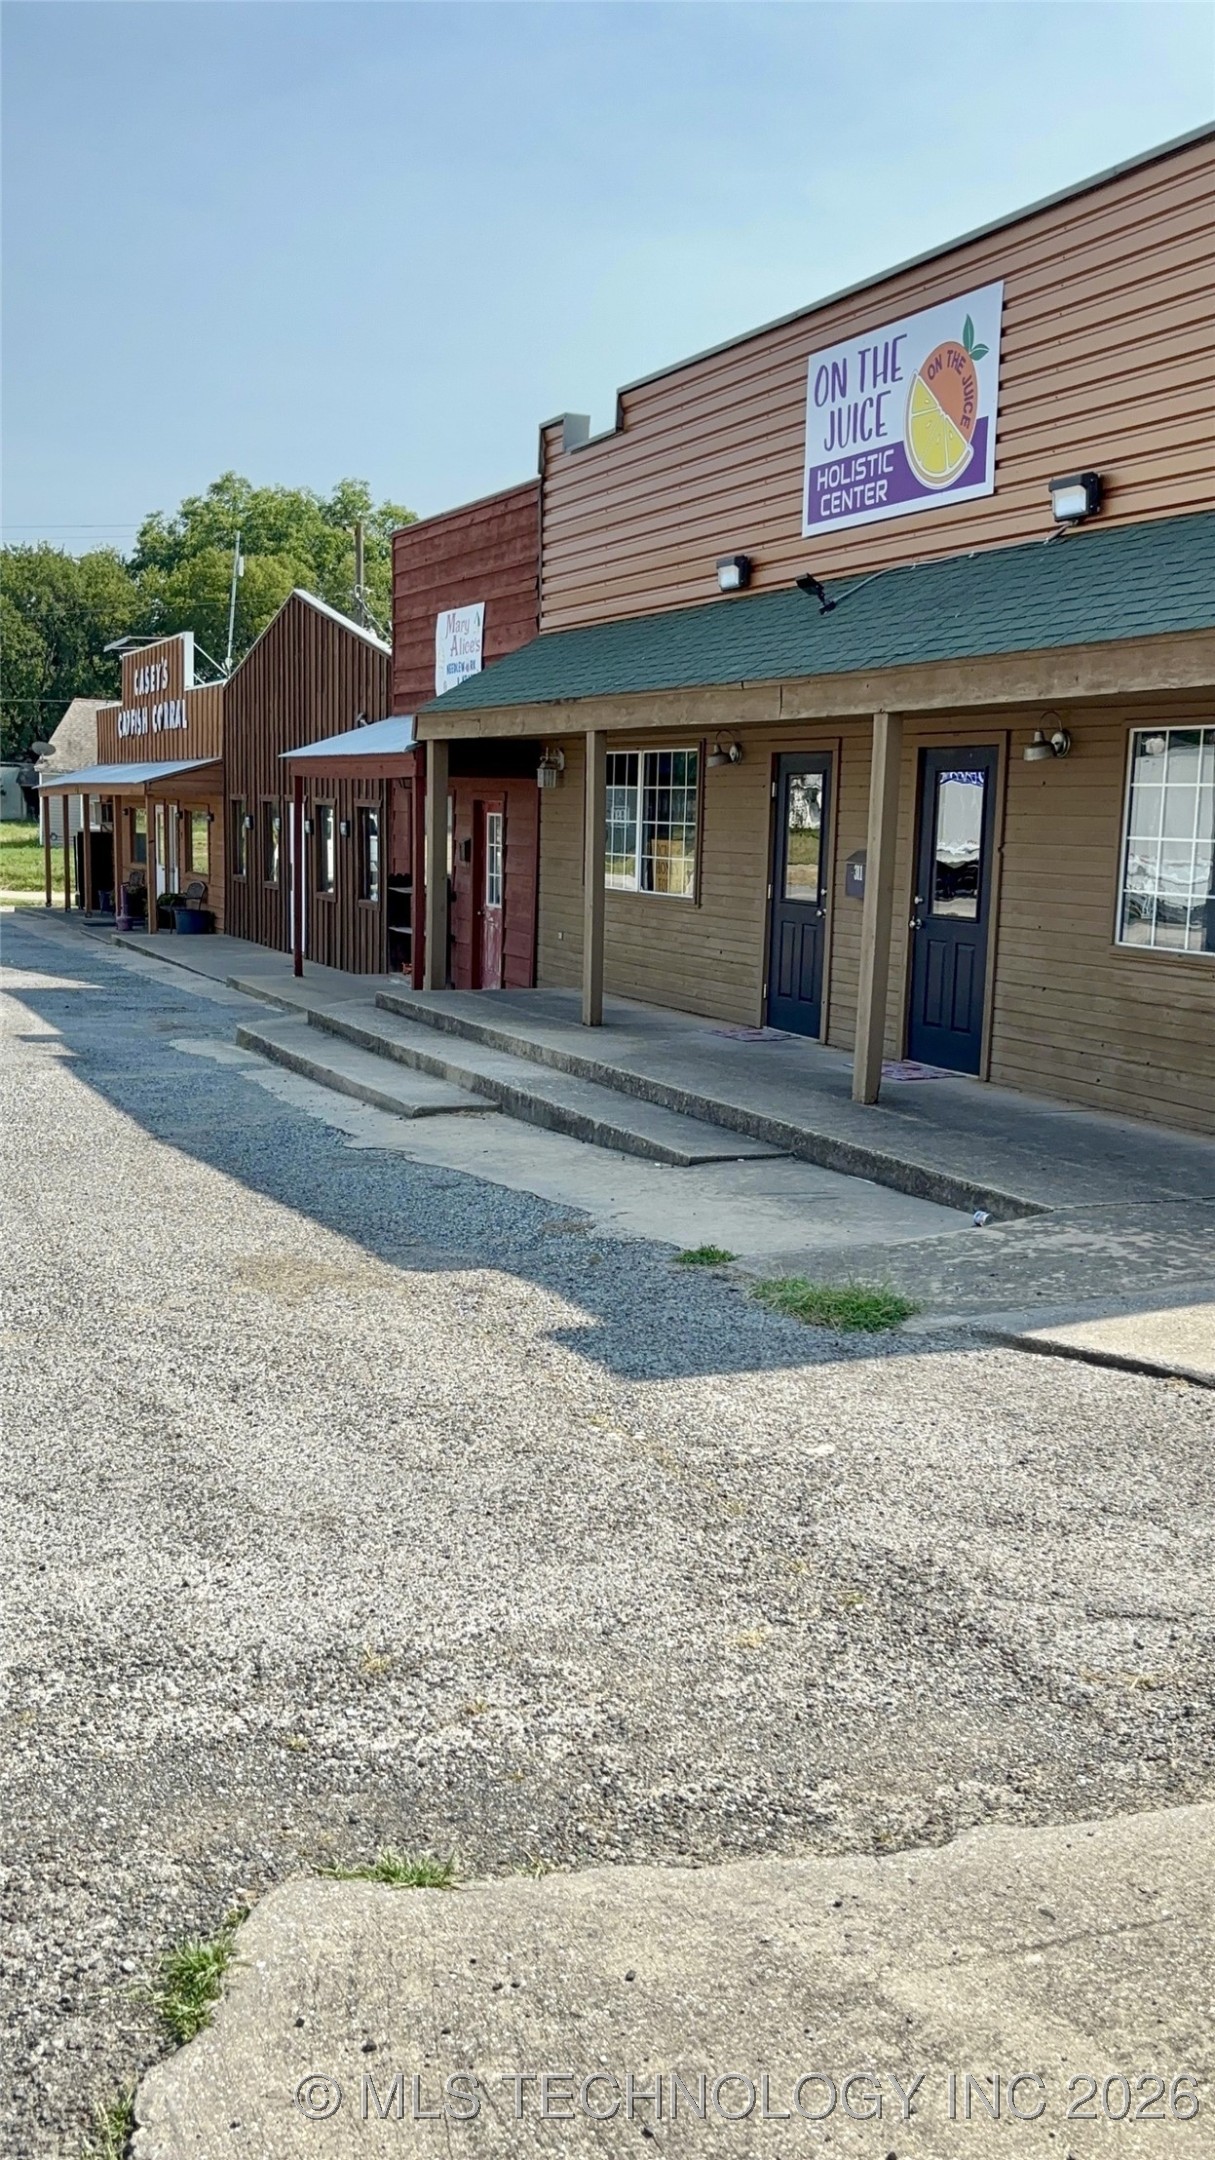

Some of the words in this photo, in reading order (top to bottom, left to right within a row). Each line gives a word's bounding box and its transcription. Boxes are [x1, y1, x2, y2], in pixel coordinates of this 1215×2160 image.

[814, 358, 847, 408] ON
[858, 333, 908, 393] THE
[927, 354, 943, 380] ON
[947, 349, 967, 375] THE
[959, 375, 975, 430] JUICE
[824, 390, 892, 452] JUICE
[817, 449, 895, 491] HOLISTIC
[820, 479, 888, 517] CENTER
[445, 613, 470, 640] Mary
[450, 634, 481, 657] Alice's
[134, 656, 169, 696] CASEY'S
